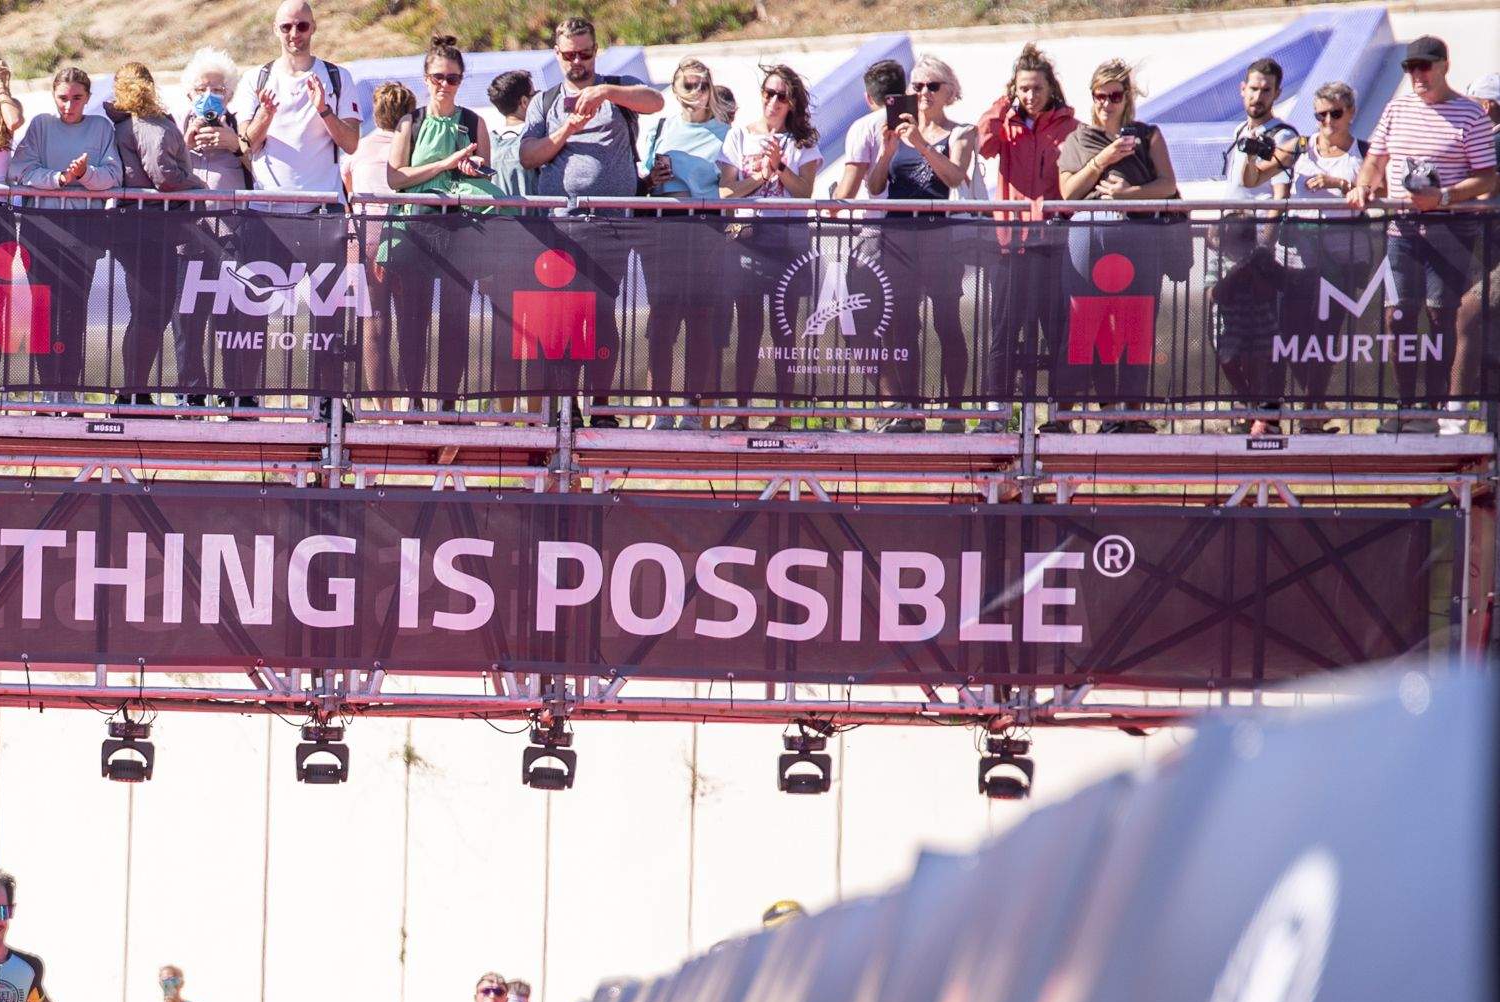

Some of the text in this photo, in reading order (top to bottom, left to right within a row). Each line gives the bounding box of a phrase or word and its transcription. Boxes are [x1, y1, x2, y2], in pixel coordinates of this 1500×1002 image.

[178, 260, 373, 317] HOKA
[215, 330, 335, 351] TIME TO FLY
[757, 347, 820, 360] ATHLETIC
[826, 348, 889, 360] BREWING
[1272, 333, 1443, 363] MAURTEN
[398, 537, 496, 631] IS
